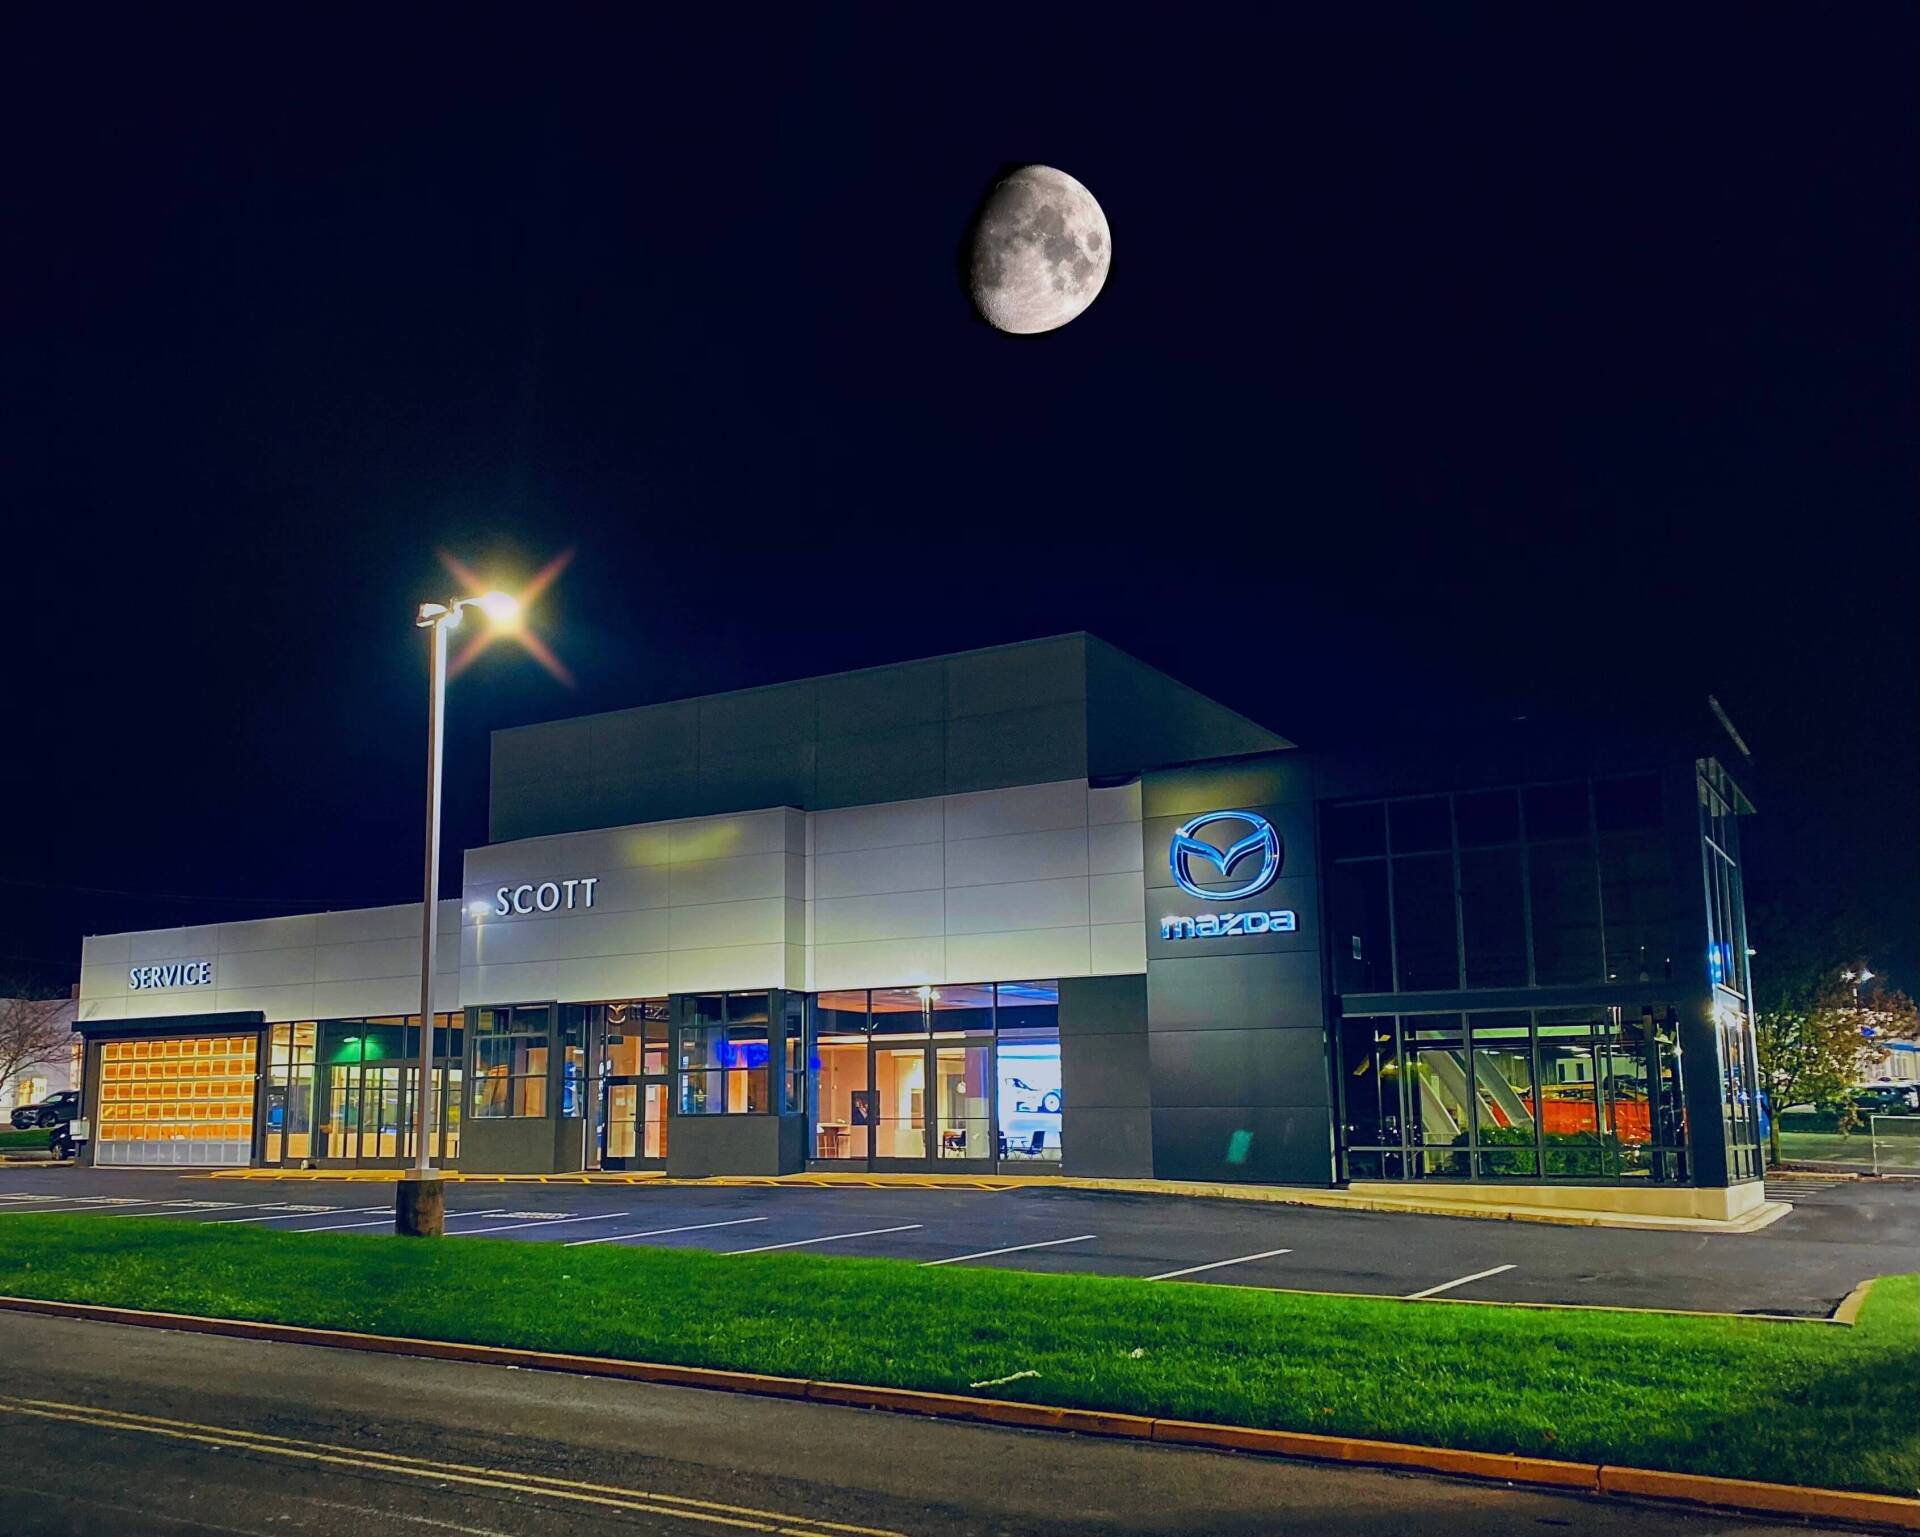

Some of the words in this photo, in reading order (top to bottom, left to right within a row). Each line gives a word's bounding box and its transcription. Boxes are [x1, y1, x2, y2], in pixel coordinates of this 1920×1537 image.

[495, 878, 598, 916] SCOTT
[1160, 910, 1296, 939] mazda
[128, 962, 211, 989] SERVICE
